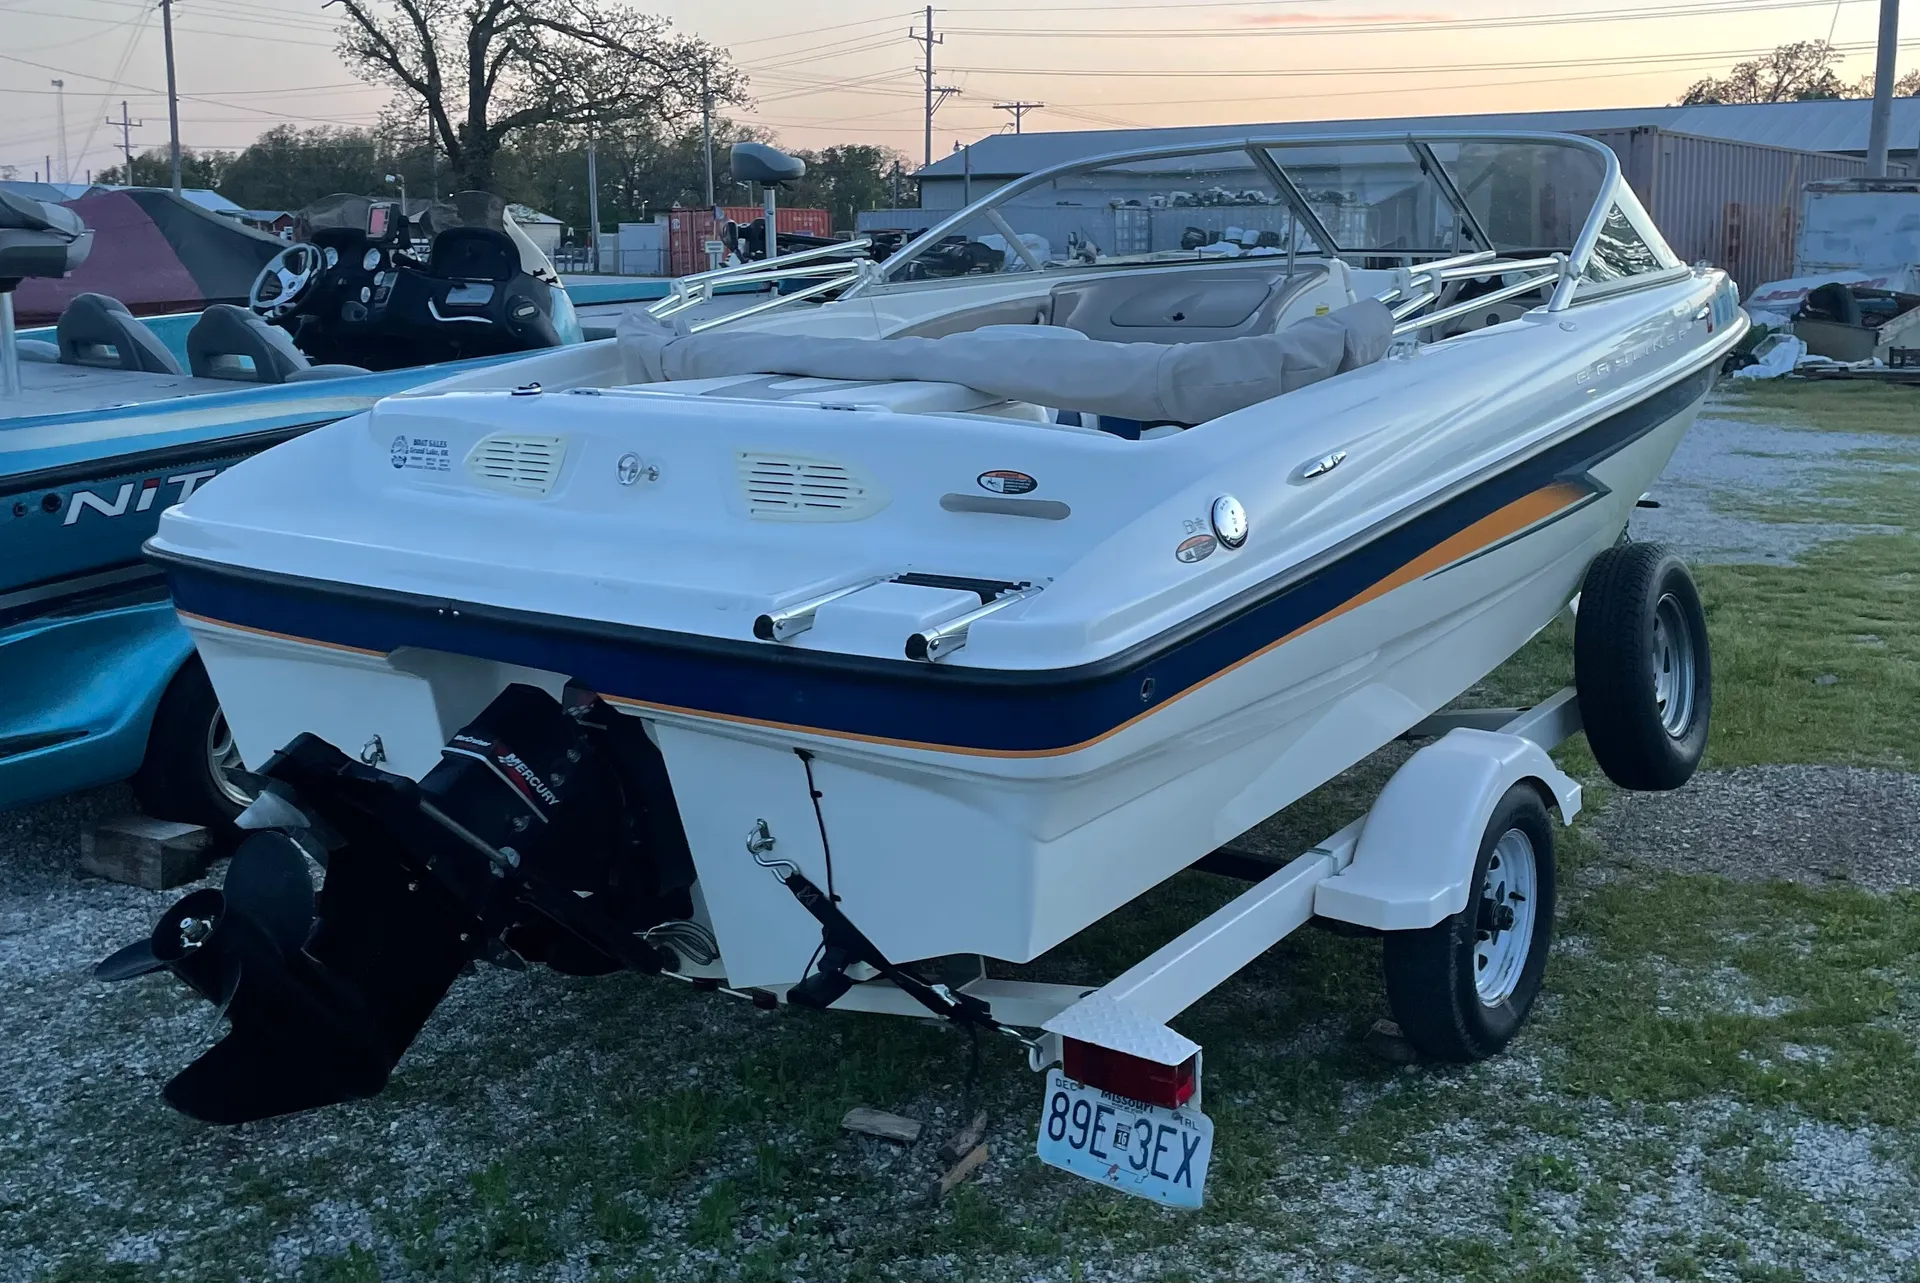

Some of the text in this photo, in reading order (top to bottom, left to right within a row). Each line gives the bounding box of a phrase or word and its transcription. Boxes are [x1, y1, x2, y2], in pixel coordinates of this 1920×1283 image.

[428, 440, 448, 448] SALES
[499, 753, 560, 805] MERCURY
[1055, 1077, 1078, 1092] DEC
[1100, 1088, 1154, 1114] Missouri
[1047, 1091, 1202, 1189] 89E 3EX
[1116, 1131, 1128, 1145] 16
